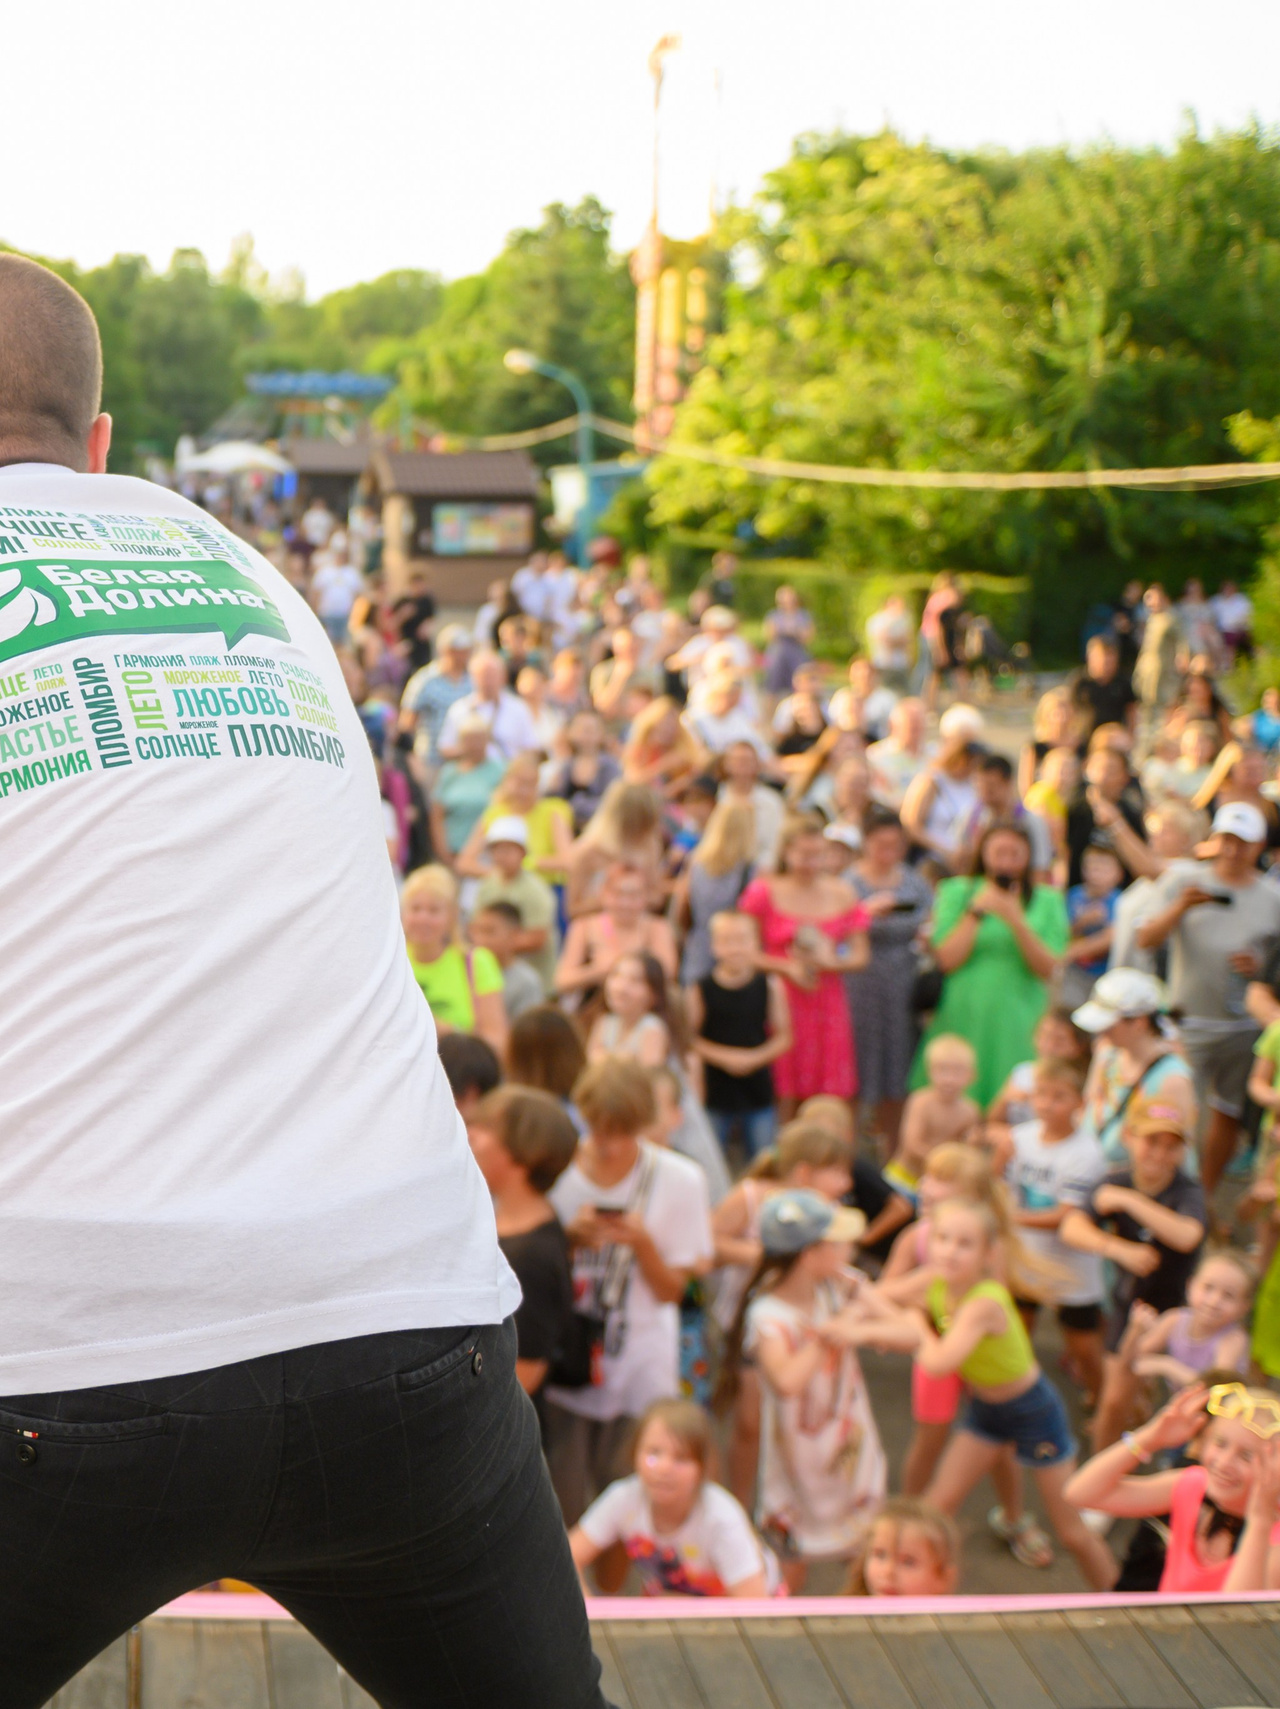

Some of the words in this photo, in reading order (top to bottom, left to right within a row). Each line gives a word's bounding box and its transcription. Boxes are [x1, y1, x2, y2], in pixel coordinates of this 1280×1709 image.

[111, 526, 167, 541] ПЛЯЖ
[110, 543, 181, 557] ПЛОМБИР
[36, 564, 206, 586] Белая
[61, 584, 266, 617] Долина
[33, 663, 63, 680] ЛЕТО
[114, 654, 186, 668] ГАРМОНИЯ
[189, 655, 221, 666] ПЛЯЖ
[224, 655, 276, 670] ПЛОМБИР
[36, 676, 67, 692] ПЛЯЖ
[163, 670, 244, 684] МОРОЖЕНОЕ
[248, 670, 284, 688] ЛЕТО
[121, 670, 168, 730] ЛЕТО
[172, 686, 290, 717] ЛЮБОВЬ
[286, 679, 335, 713] ПЛЯЖ
[72, 657, 133, 769] ПЛОМБИР
[294, 703, 340, 733] СОЛНЦЕ
[179, 720, 219, 730] МОРОЖЕНОЕ
[135, 732, 221, 760] СОЛНЦЕ
[227, 723, 345, 769] ПЛОМБИР
